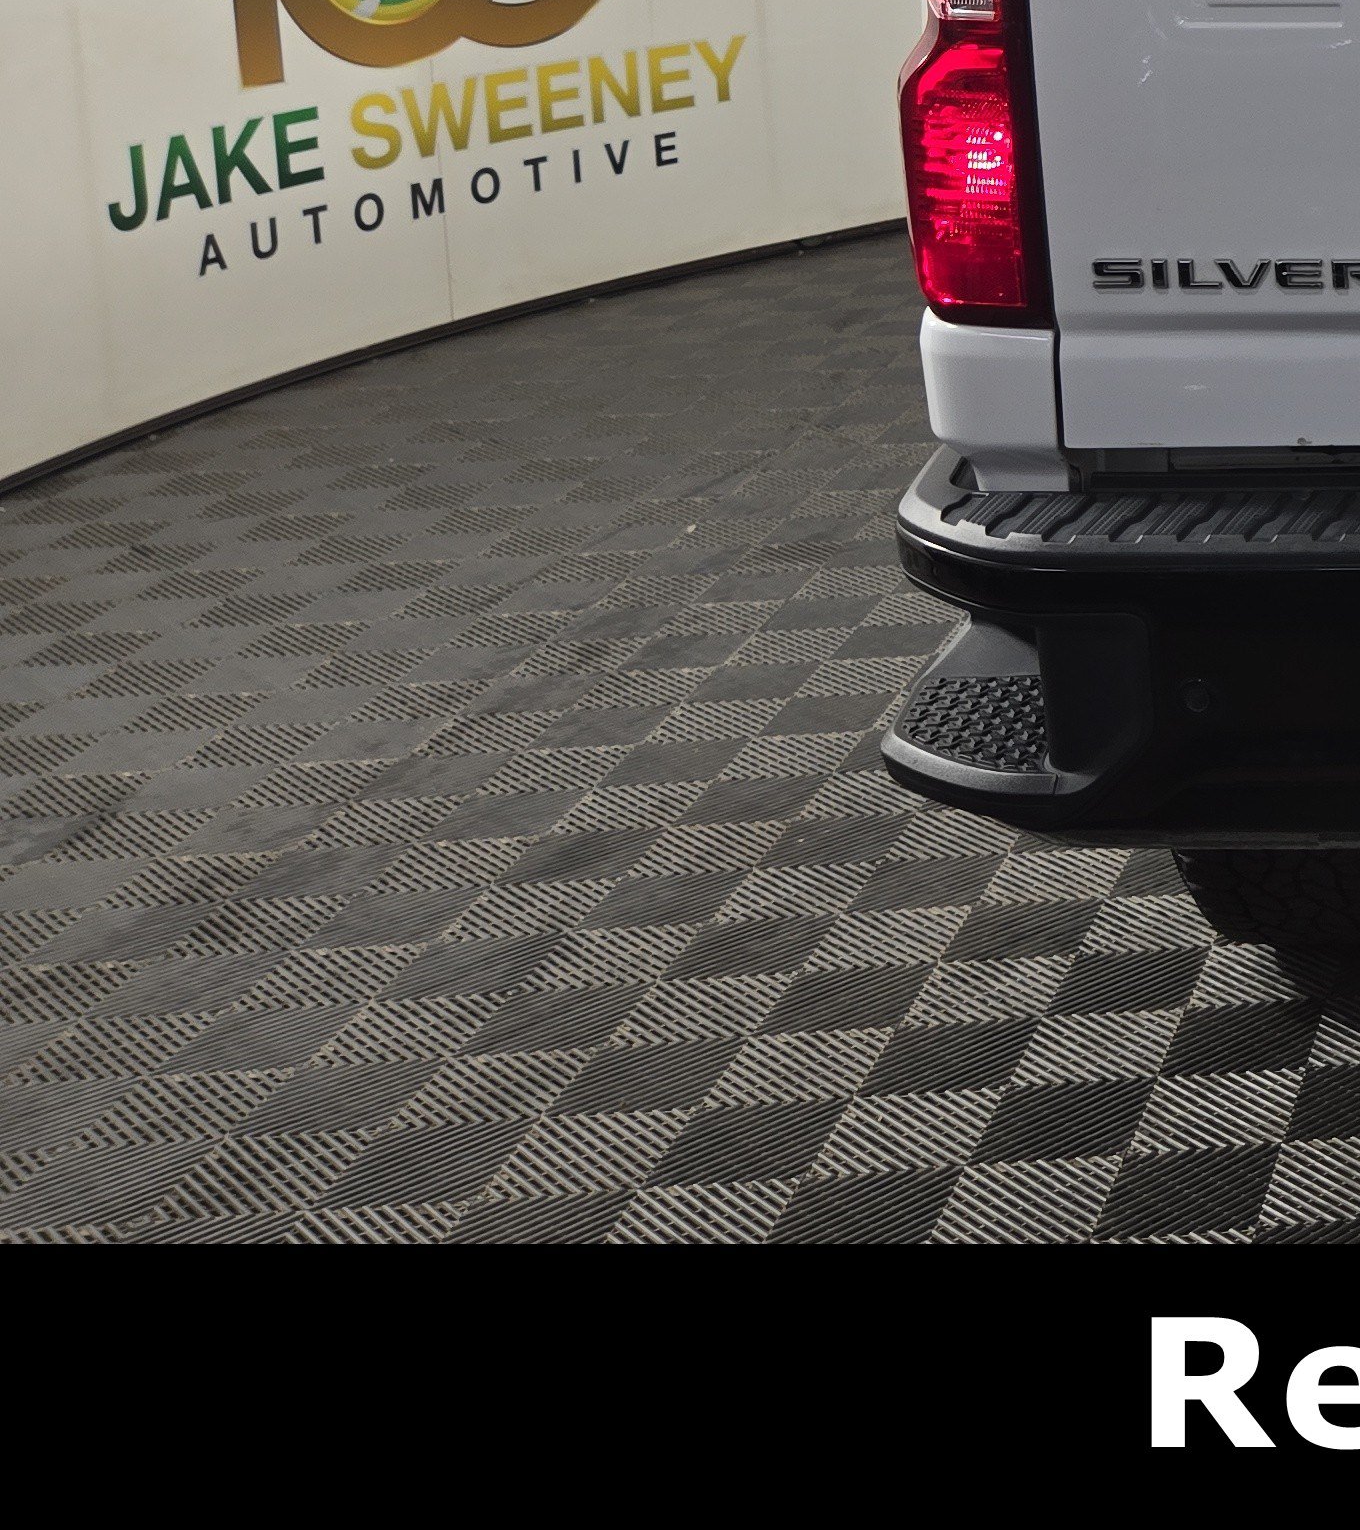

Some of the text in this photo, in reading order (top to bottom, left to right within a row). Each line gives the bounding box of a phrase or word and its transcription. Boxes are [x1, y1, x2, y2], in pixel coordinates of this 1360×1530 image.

[107, 34, 748, 233] JAKE SWEENEY
[198, 131, 681, 277] AUTOMOTIVE
